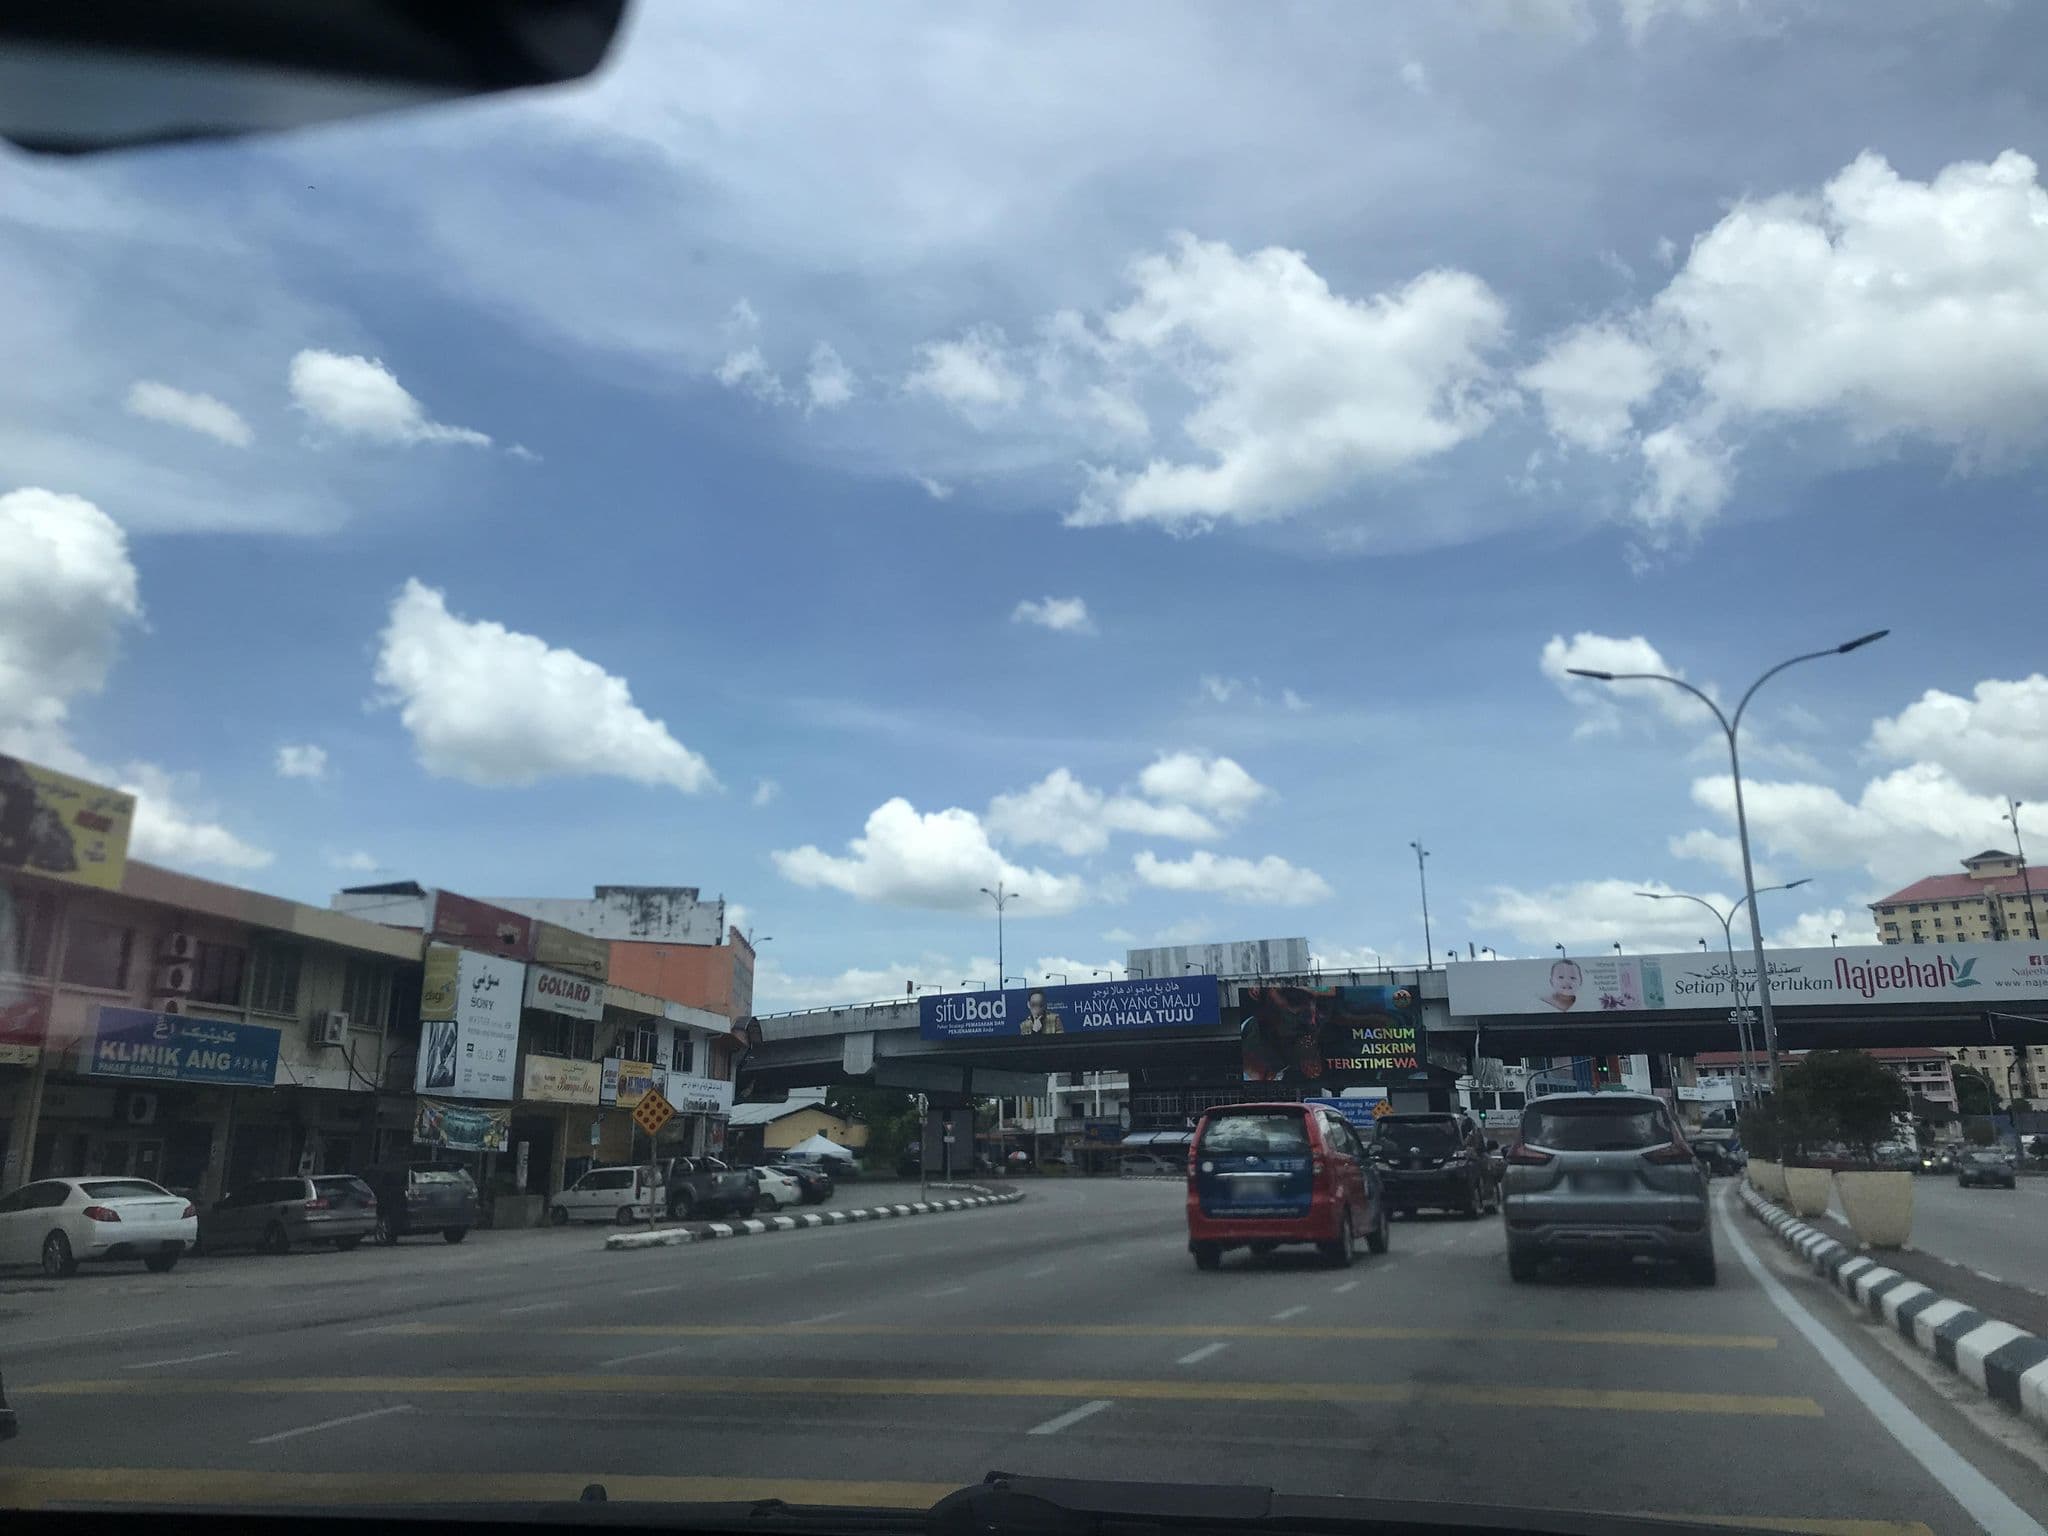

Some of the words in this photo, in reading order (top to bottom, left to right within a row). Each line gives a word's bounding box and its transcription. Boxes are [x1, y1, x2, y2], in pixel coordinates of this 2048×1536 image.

[1834, 955, 1954, 998] Najeehah
[1675, 980, 1725, 996] Setiap
[470, 997, 494, 1010] SONY
[936, 994, 1006, 1022] sifuBad
[1074, 999, 1118, 1013] HANYA
[1120, 996, 1158, 1010] YANG
[1162, 993, 1201, 1007] MAJU
[1083, 1013, 1112, 1027] ADA
[1116, 1011, 1153, 1025] HALA
[1156, 1009, 1194, 1023] TUJU
[1352, 1028, 1415, 1040] MAGNUM
[101, 1041, 181, 1067] KLINIK
[186, 1050, 231, 1071] ANG
[1361, 1043, 1416, 1055] AISKRIM
[1327, 1058, 1418, 1069] TERISTIMEWA
